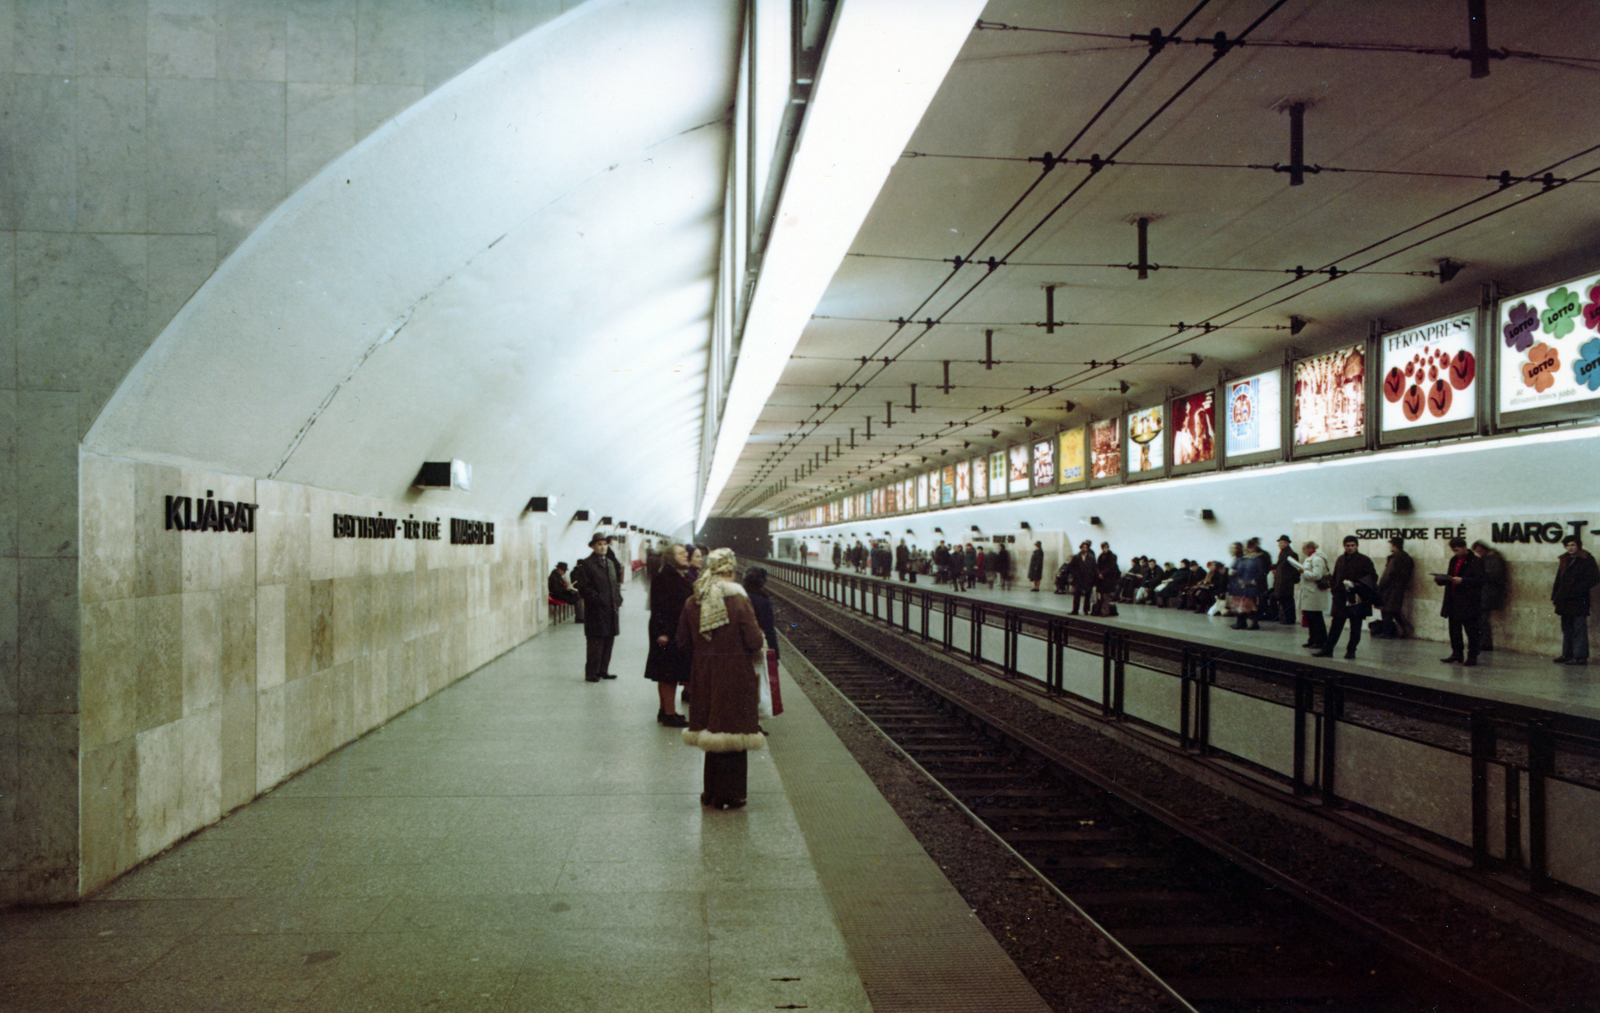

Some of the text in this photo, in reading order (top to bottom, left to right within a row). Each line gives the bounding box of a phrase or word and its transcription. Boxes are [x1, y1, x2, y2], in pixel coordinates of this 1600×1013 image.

[1548, 302, 1575, 325] LOTTO
[1508, 317, 1535, 339] LOTTO
[1528, 357, 1555, 378] LOTTO
[165, 489, 259, 533] KIJÁRAT
[422, 516, 441, 541] FELÉ
[1355, 523, 1467, 540] SZENTENDRE FELÉ
